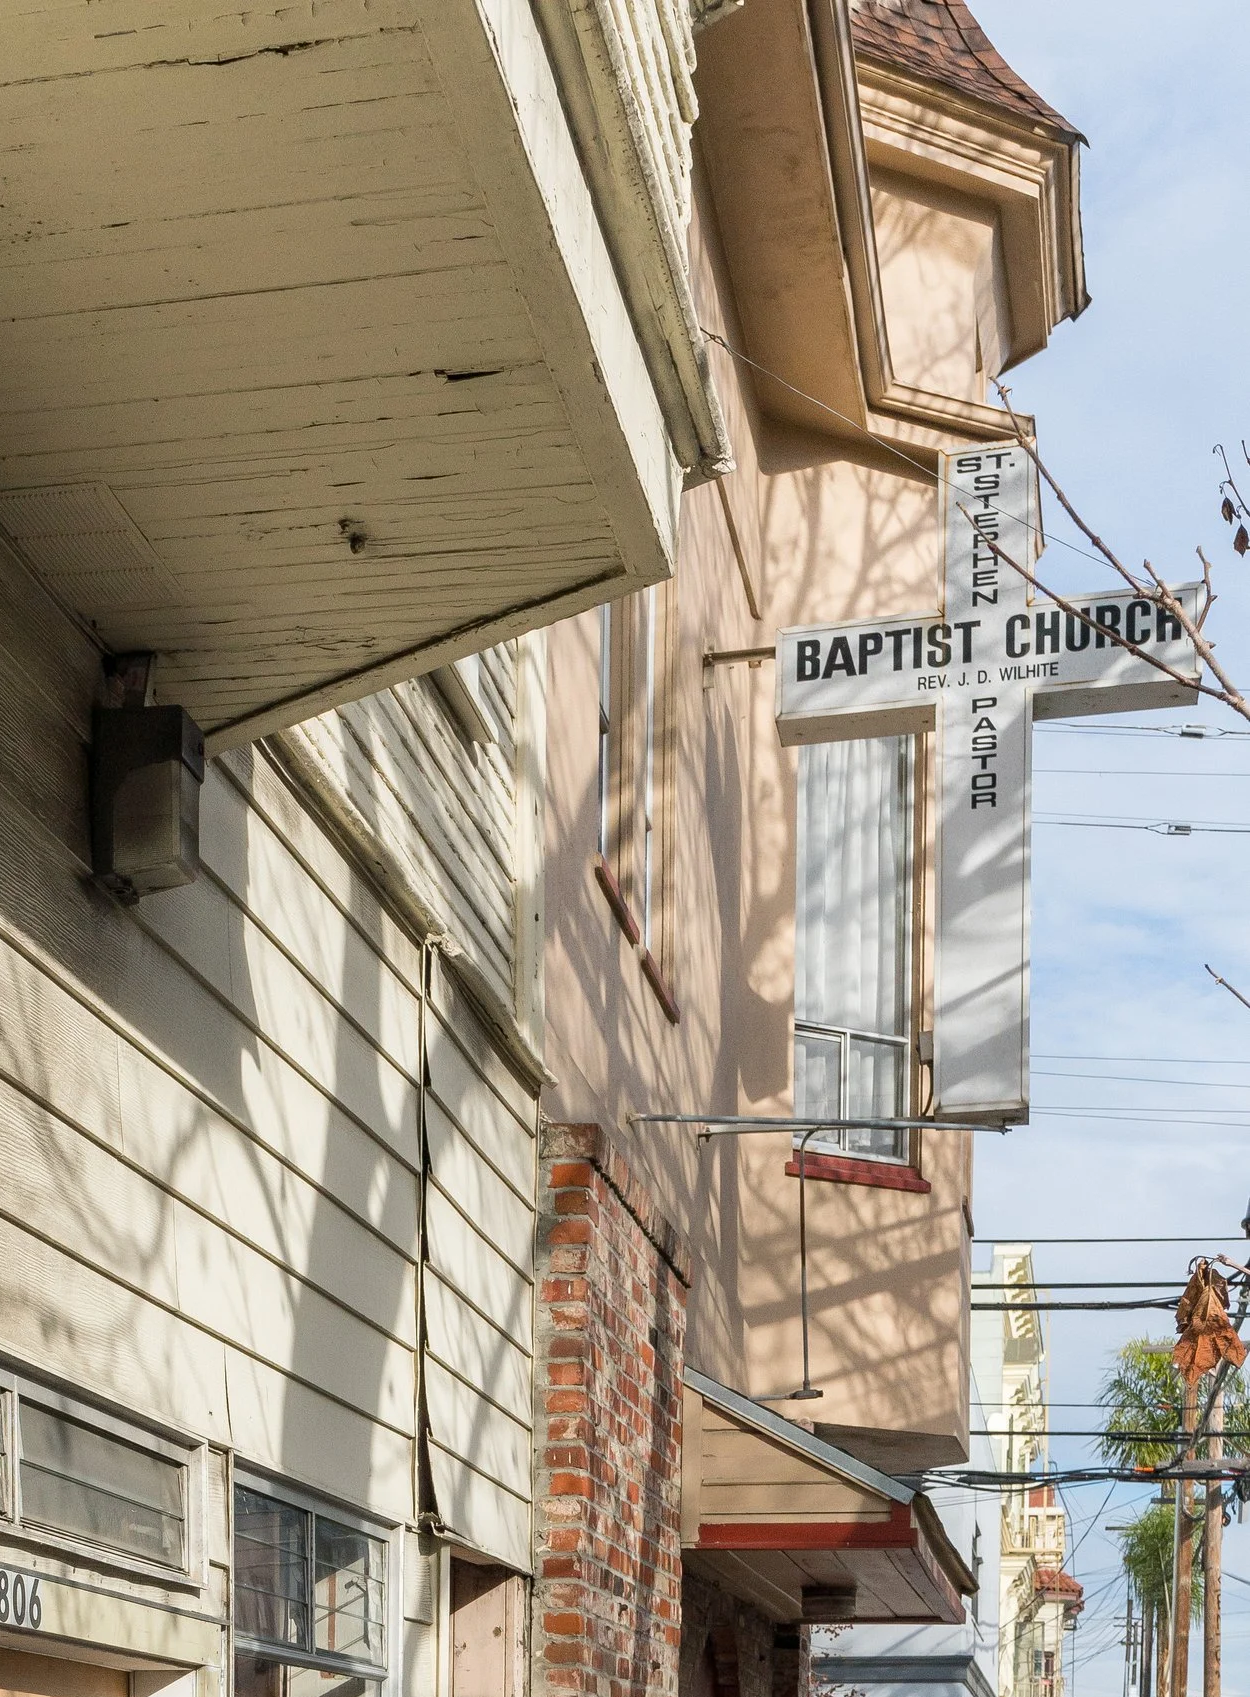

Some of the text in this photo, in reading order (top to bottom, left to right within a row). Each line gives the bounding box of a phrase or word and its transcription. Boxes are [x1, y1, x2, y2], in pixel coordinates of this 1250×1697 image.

[956, 452, 1015, 474] ST.
[972, 474, 1000, 607] STEPHEN
[796, 597, 1183, 682] BAPTIST CHURCH
[917, 661, 1059, 690] REV. J. D. WILHITE
[971, 697, 998, 809] PASTOR
